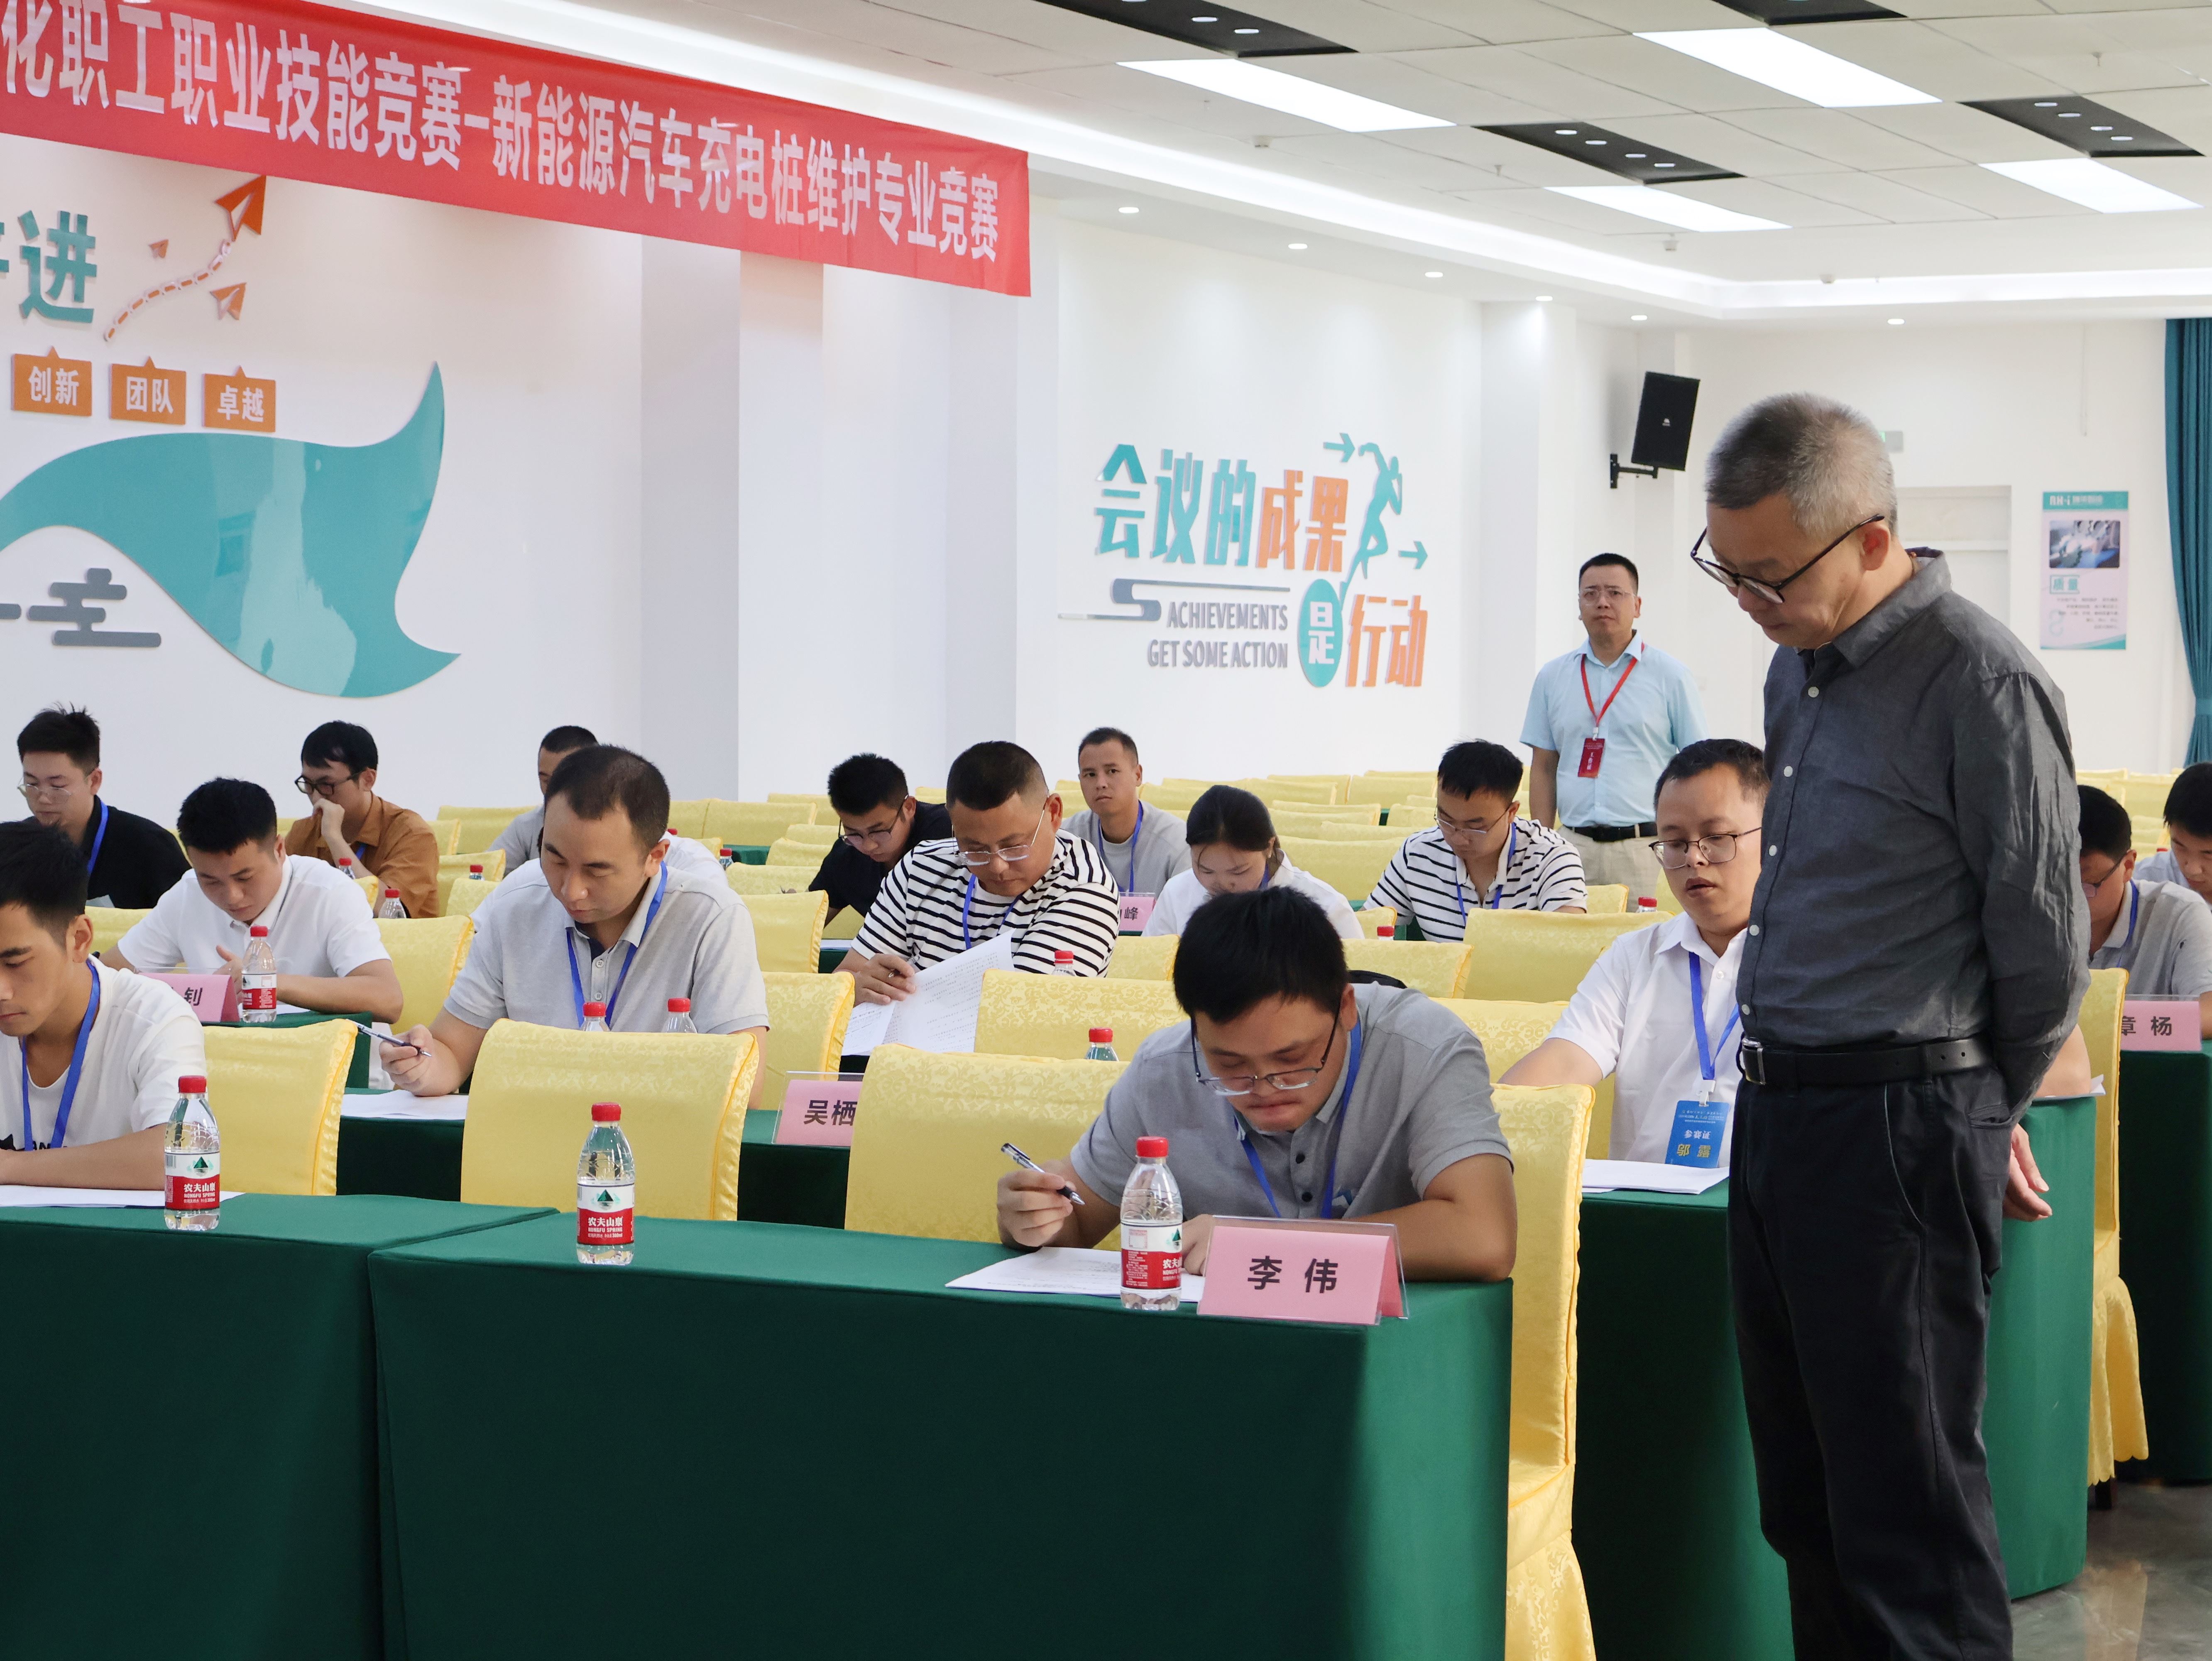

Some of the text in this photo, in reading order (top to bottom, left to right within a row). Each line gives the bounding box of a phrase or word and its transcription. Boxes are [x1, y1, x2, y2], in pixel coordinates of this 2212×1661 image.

[0, 210, 97, 323] 进
[28, 366, 80, 406] 创新
[126, 376, 174, 414] 团队
[217, 385, 265, 422] 卓越
[1094, 443, 1348, 572] 会议的成果
[1166, 601, 1288, 630] ACHIEVEMENTS
[1147, 639, 1288, 669] GET SOME ACTION
[1345, 594, 1428, 687] 行动
[1120, 906, 1138, 921] 峰
[184, 1182, 215, 1192] 农夫山泉
[588, 1217, 622, 1227] 农夫山泉
[1247, 1255, 1338, 1294] 李伟
